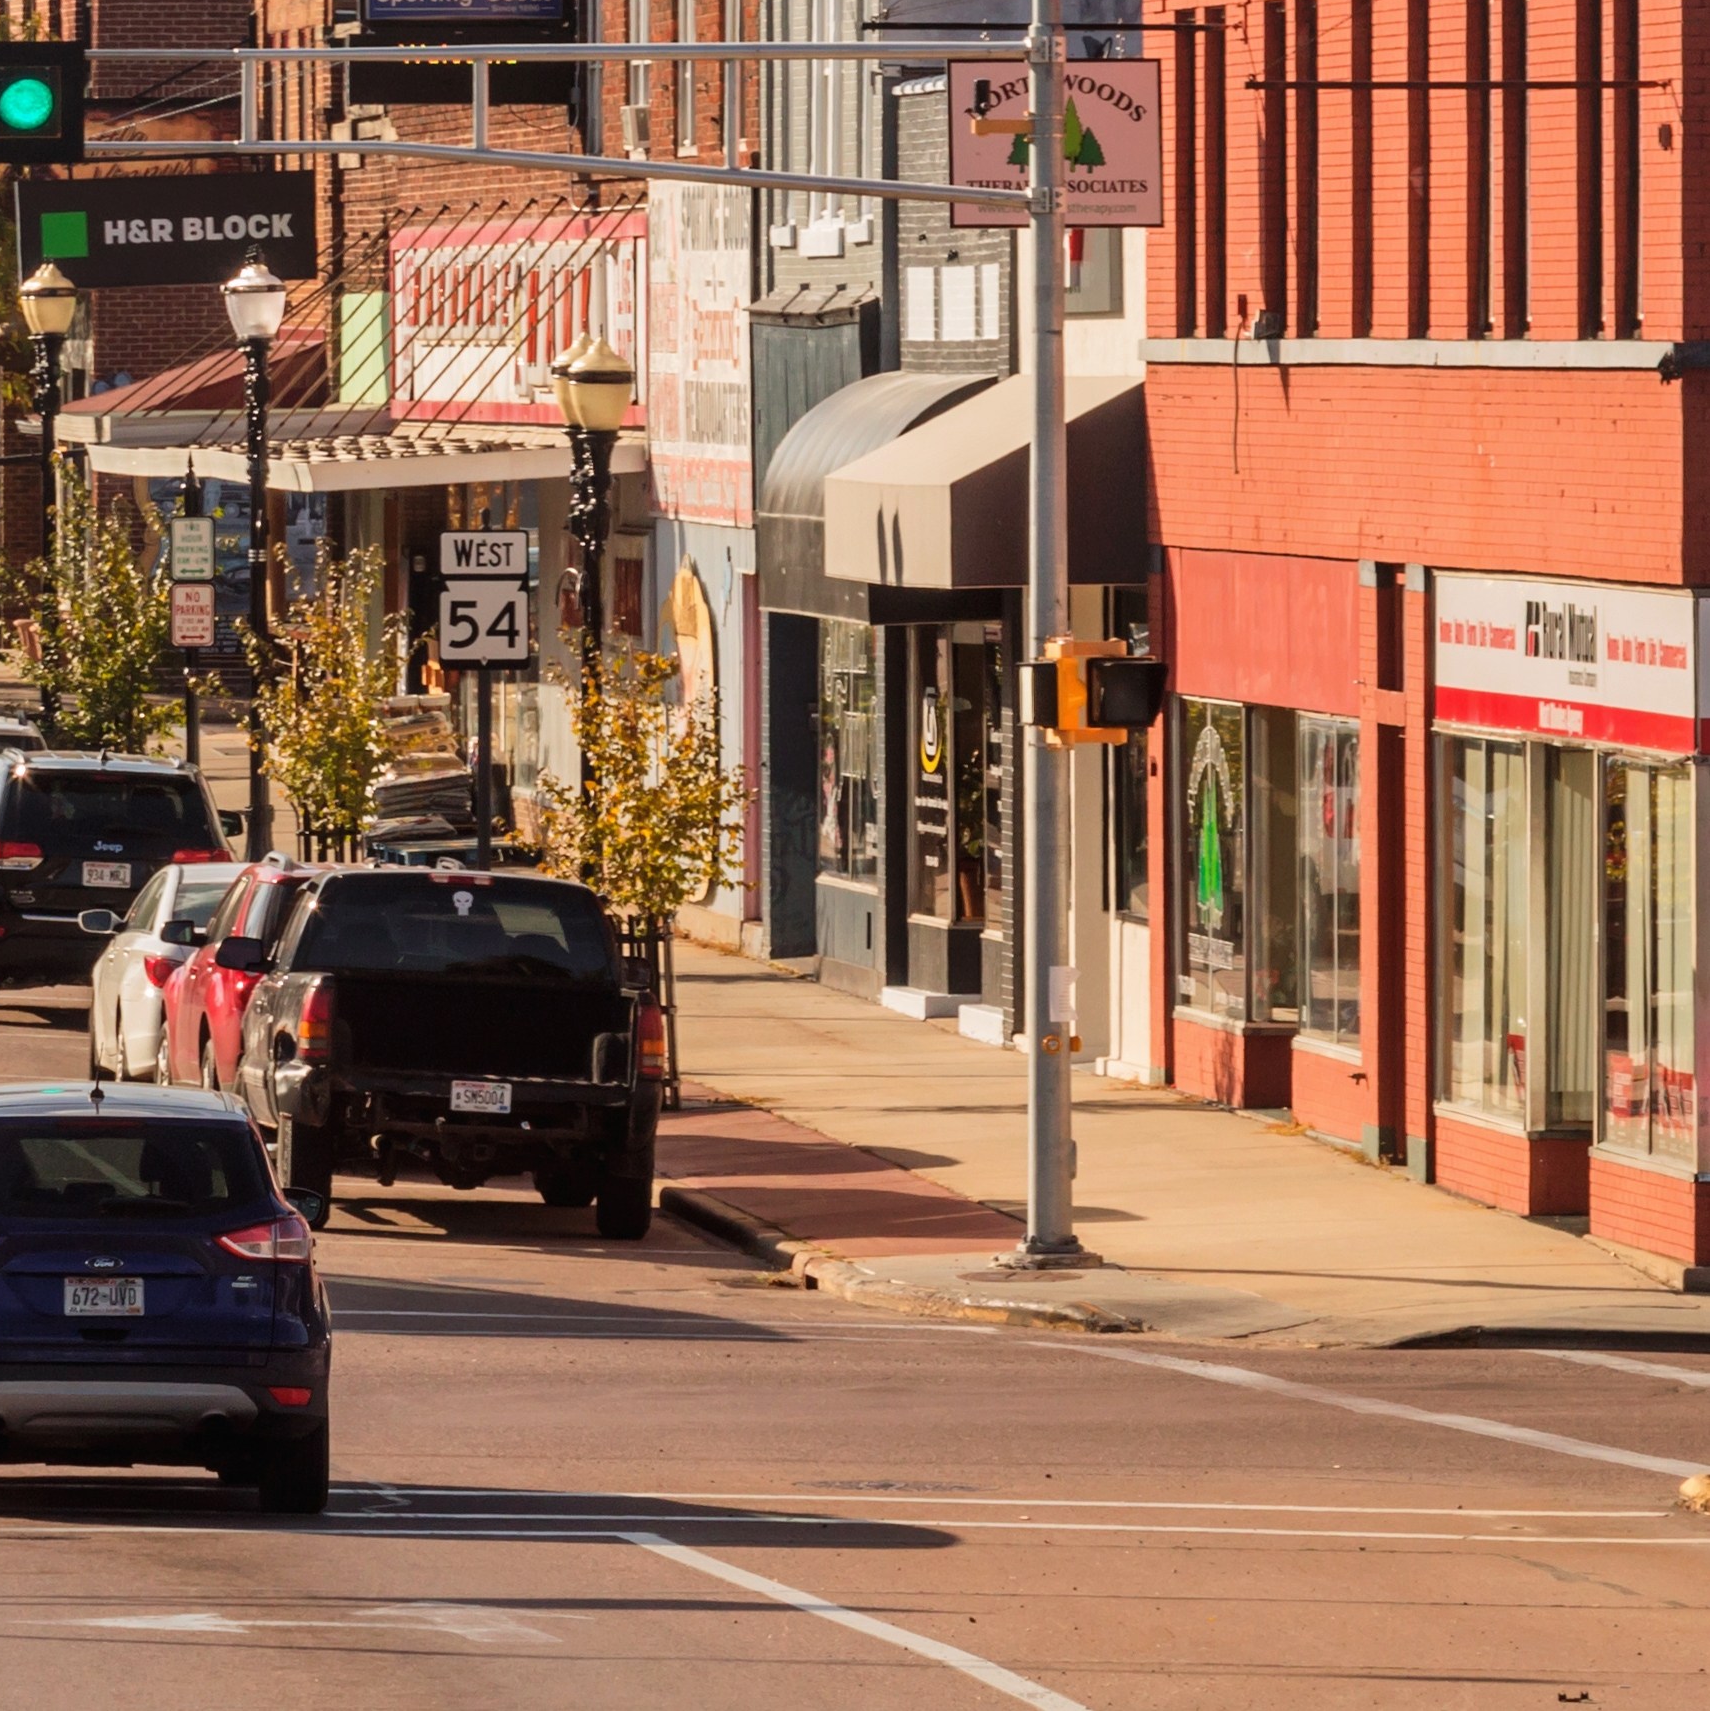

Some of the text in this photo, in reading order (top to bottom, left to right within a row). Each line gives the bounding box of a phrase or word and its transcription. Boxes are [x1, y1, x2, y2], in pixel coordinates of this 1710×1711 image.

[103, 213, 295, 245] H&R BLOCK
[453, 539, 514, 568] WEST
[185, 592, 201, 602] NO
[176, 605, 211, 616] PARKING
[448, 600, 520, 649] 54
[1542, 601, 1598, 663] Rural Mutual
[93, 840, 124, 853] Jeep
[93, 1258, 114, 1268] Ford
[71, 1286, 137, 1307] 672-UVD
